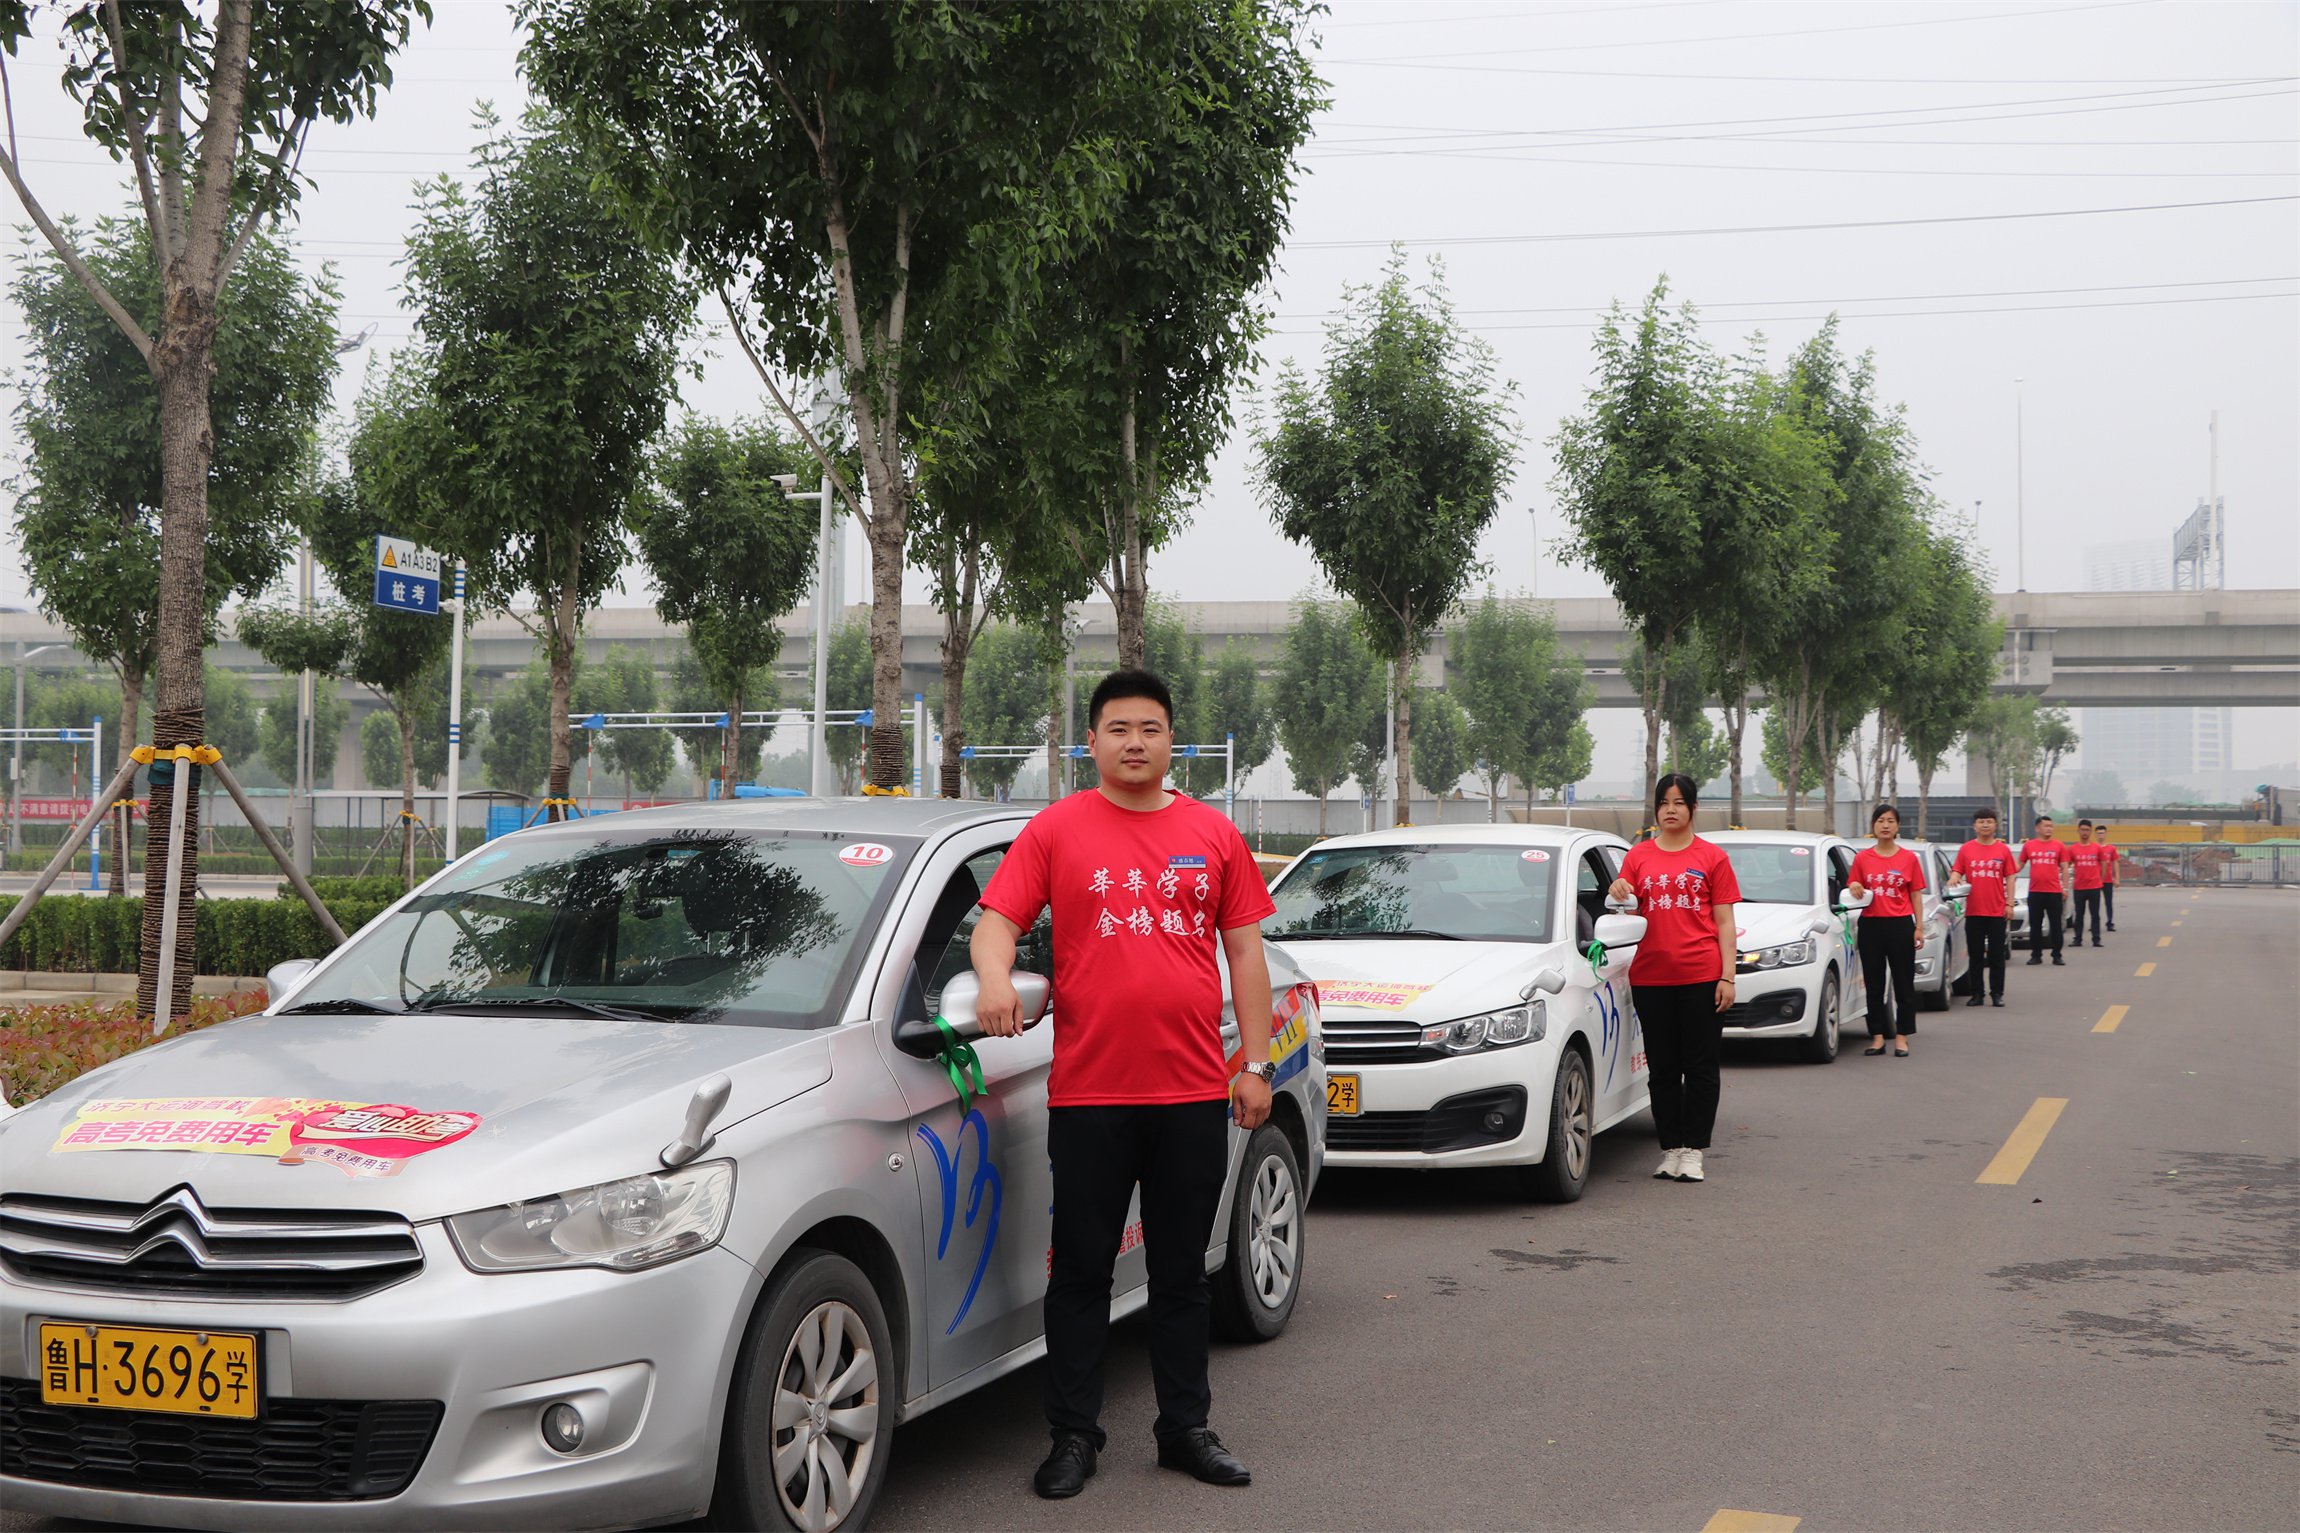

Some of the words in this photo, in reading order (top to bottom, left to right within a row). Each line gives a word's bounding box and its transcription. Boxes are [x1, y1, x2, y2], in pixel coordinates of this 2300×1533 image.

[392, 580, 425, 605] 桩考
[853, 846, 884, 859] 10
[1088, 867, 1210, 901] 莘莘学子
[1094, 905, 1206, 938] 金榜题名
[63, 1120, 281, 1146] 高考免费用车
[302, 1146, 393, 1172] 高考免费用车
